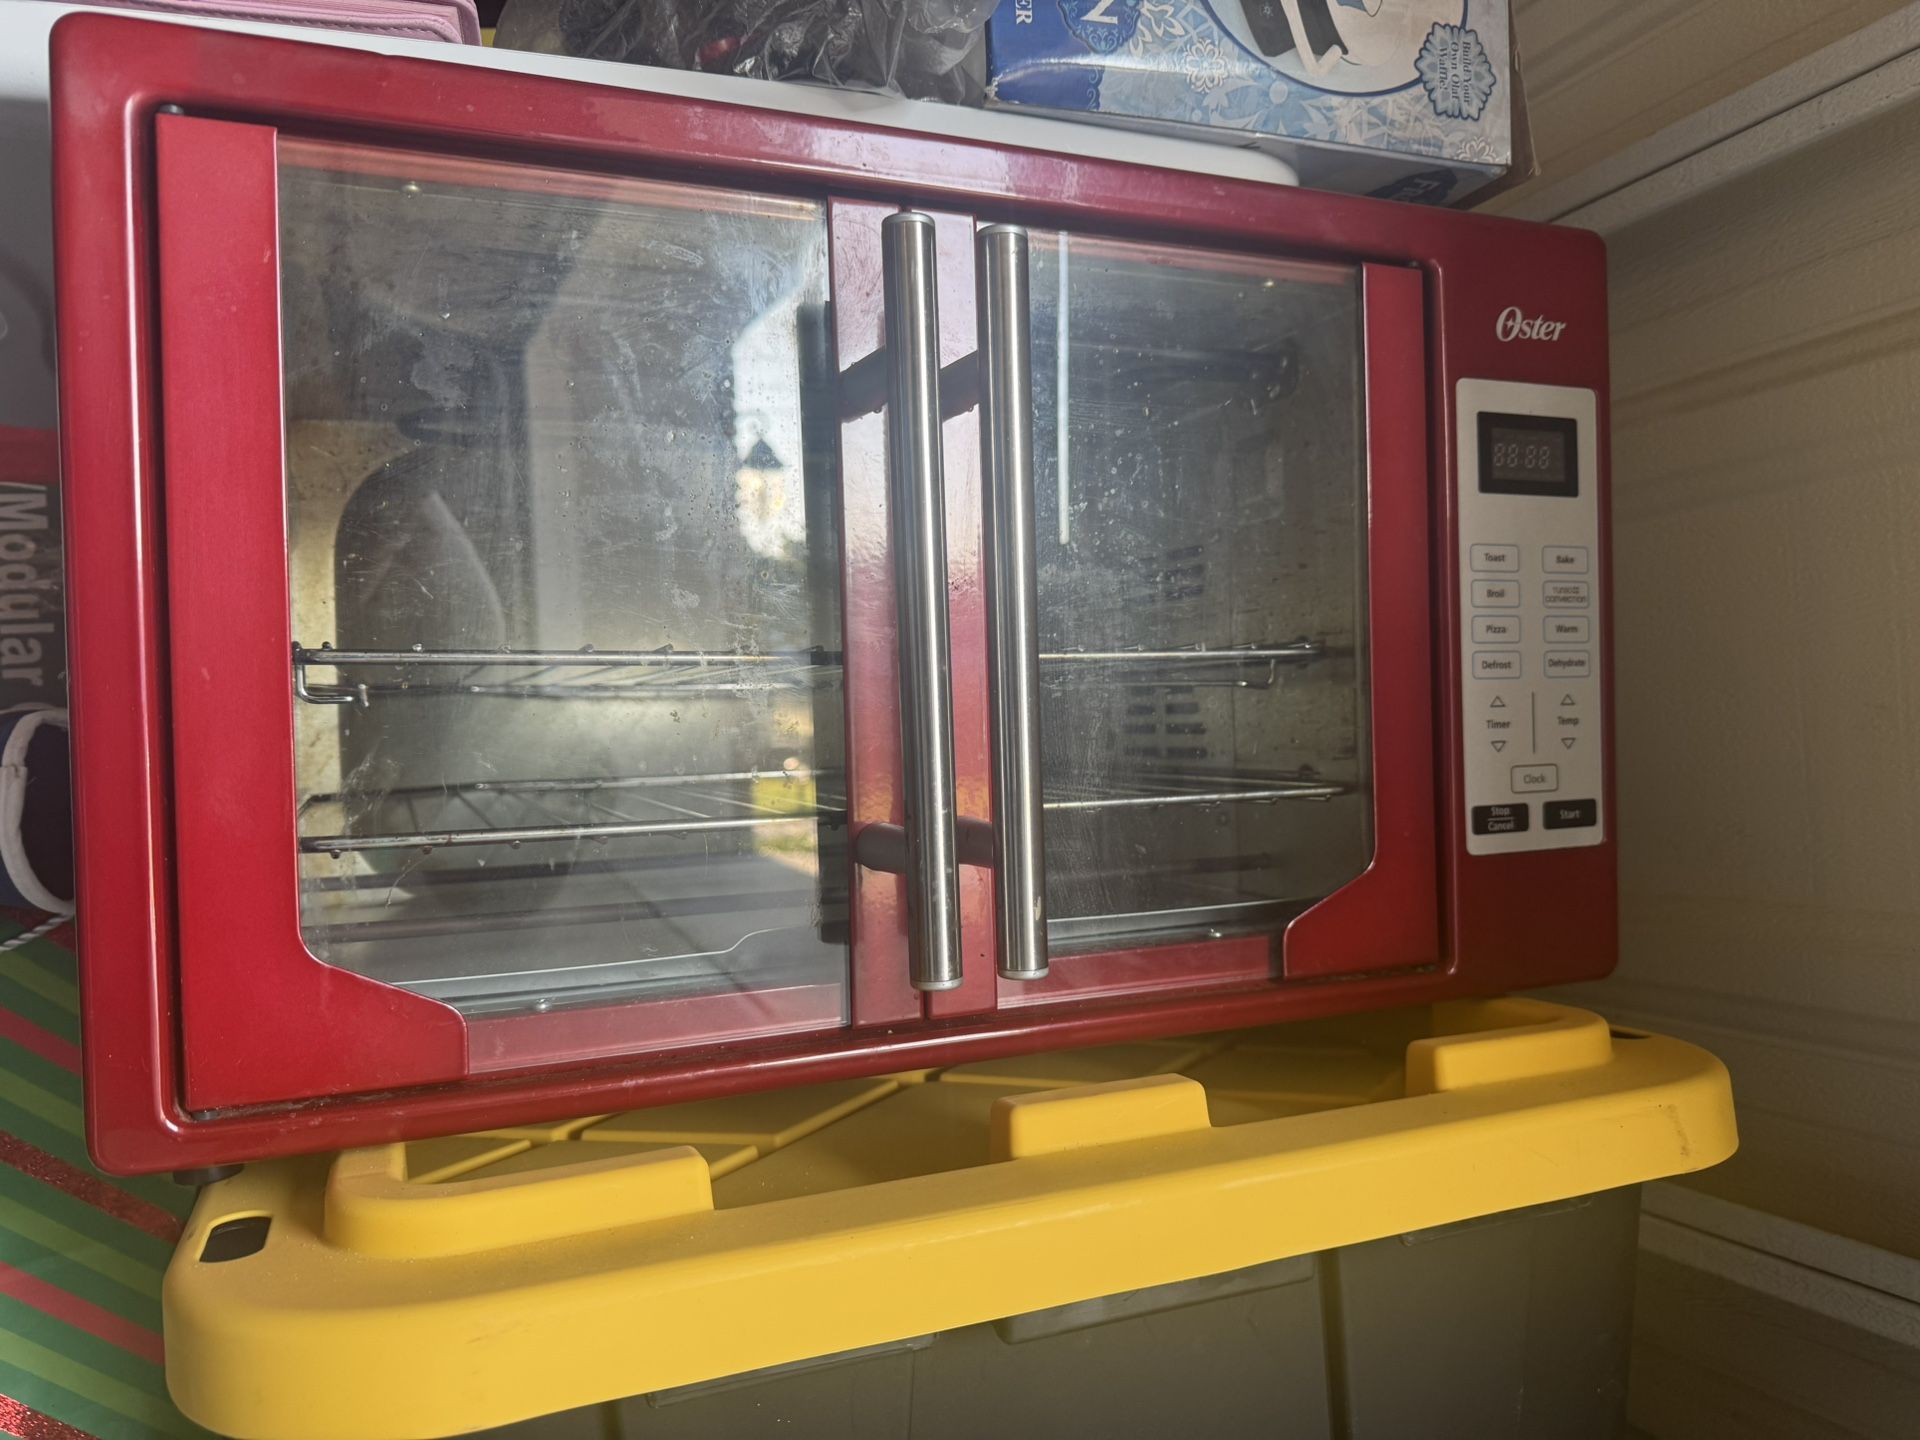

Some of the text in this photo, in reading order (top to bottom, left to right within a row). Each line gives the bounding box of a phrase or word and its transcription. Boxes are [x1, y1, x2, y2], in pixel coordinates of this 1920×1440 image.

[1439, 47, 1448, 90] Waffle!
[1450, 41, 1460, 99] Own Olaf
[1462, 41, 1472, 103] Build Your
[1496, 306, 1566, 342] Oster
[1484, 553, 1505, 562] Toast
[1556, 556, 1575, 564] Bake
[1486, 588, 1506, 598] Broil
[1486, 624, 1507, 634] Pizza
[1555, 624, 1578, 634] Warm
[1482, 660, 1512, 670] Defrost
[1548, 659, 1585, 670] Dehydrate
[1486, 719, 1511, 729] Timer
[1557, 716, 1579, 727] Temp
[1523, 774, 1547, 785] Clock
[1491, 806, 1511, 817] Stop
[1560, 809, 1580, 820] Start
[1487, 820, 1514, 832] Cancel
